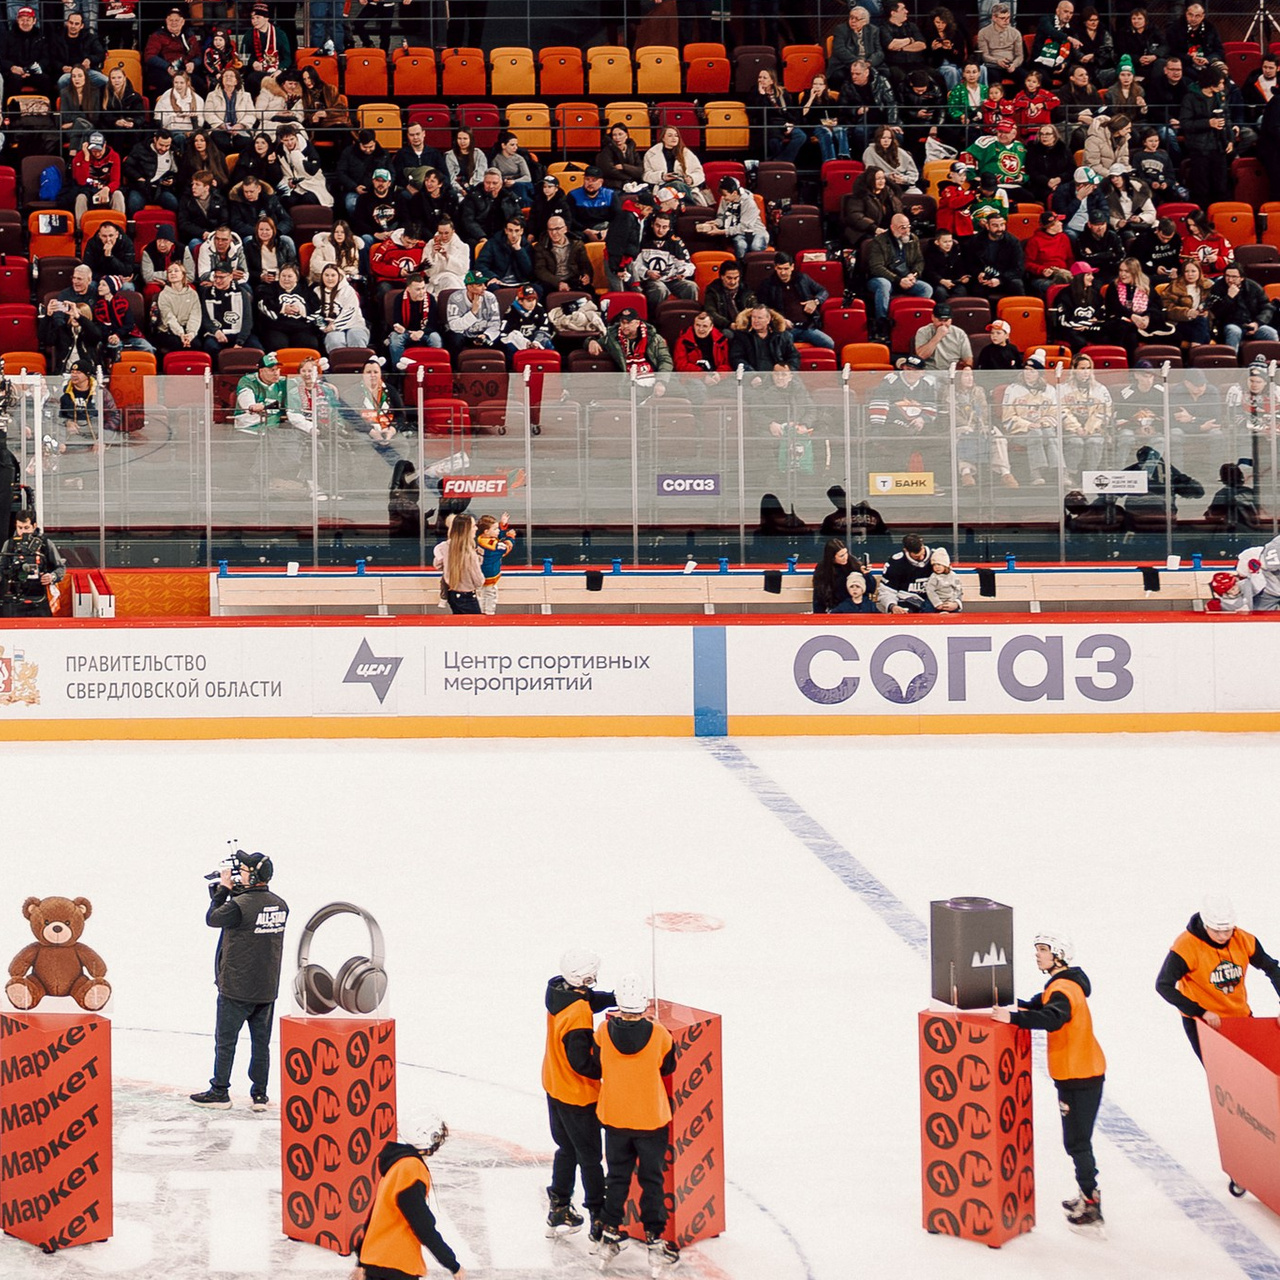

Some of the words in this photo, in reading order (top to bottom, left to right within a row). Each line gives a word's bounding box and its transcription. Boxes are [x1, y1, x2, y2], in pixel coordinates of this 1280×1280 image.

[445, 480, 506, 494] FONBET
[895, 479, 927, 488] БАНК
[66, 654, 207, 672] ПРАВИТЕЛЬСТВО
[444, 651, 512, 676] Центр
[516, 655, 650, 676] спортивных
[66, 677, 200, 701] СВЕРДЛОВСКОЙ
[205, 680, 282, 698] ОБЛАСТИ
[444, 672, 593, 696] мероприятий
[1, 1066, 99, 1144] Маркет
[1, 1114, 99, 1192] Маркет
[2, 1162, 100, 1238] Маркет
